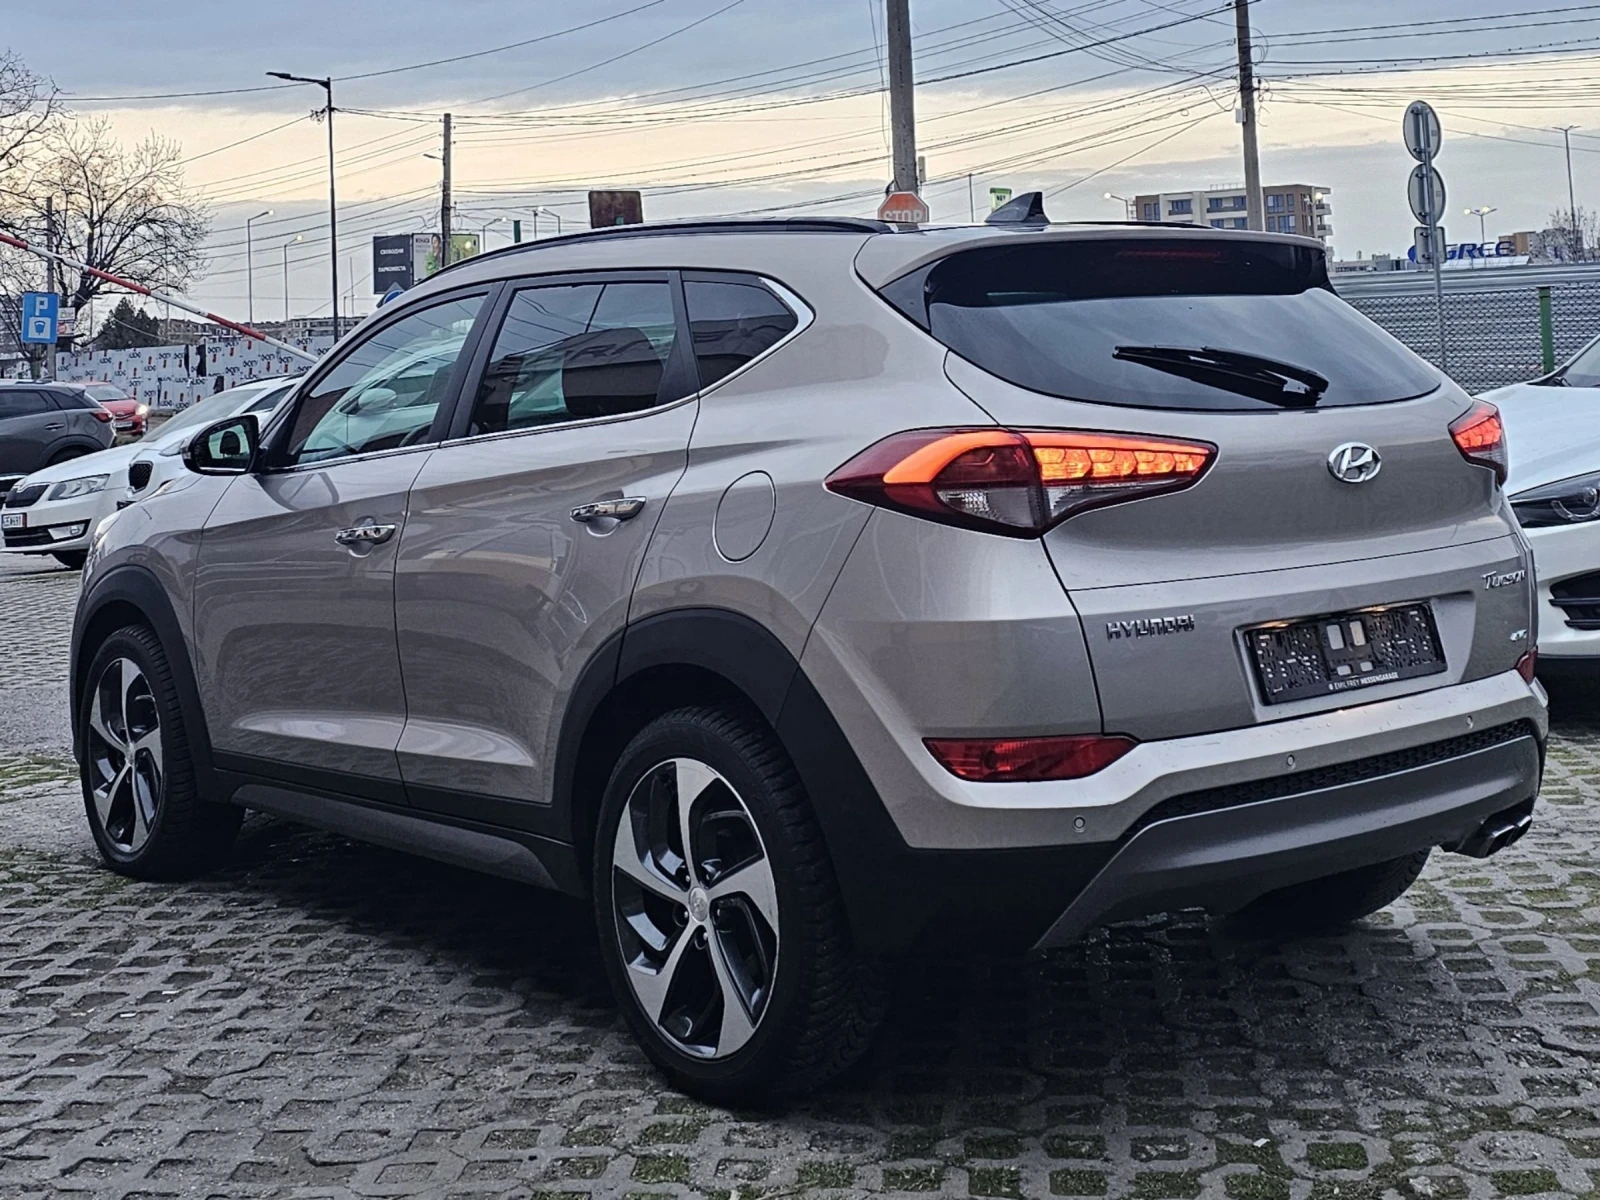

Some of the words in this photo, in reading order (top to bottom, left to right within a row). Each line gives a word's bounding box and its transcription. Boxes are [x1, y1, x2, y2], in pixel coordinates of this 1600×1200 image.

[883, 209, 922, 222] STOP
[35, 296, 49, 316] P
[1106, 614, 1195, 639] HYUNDAI
